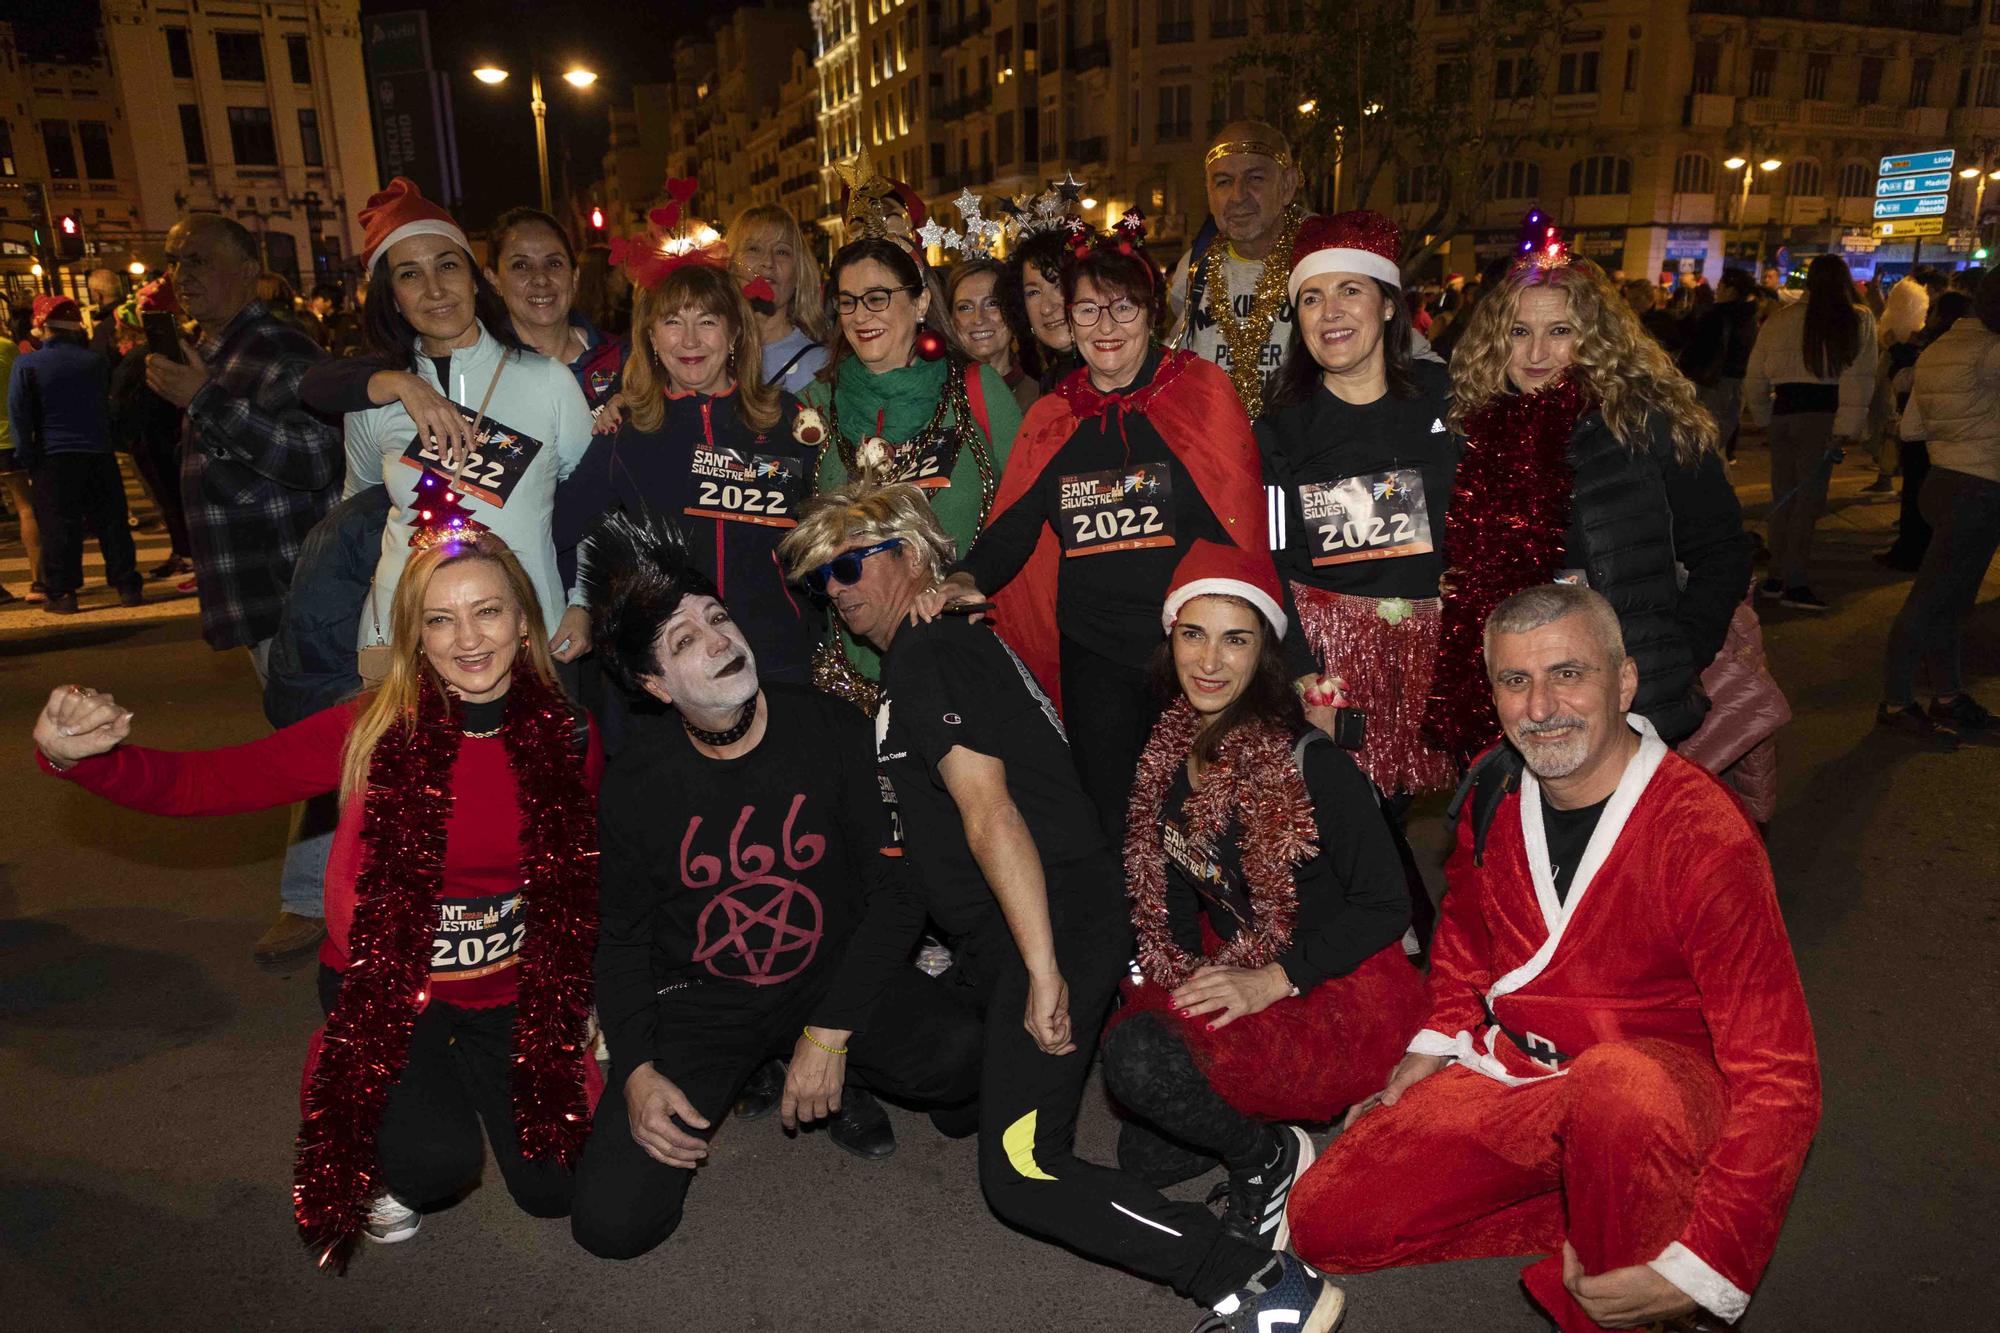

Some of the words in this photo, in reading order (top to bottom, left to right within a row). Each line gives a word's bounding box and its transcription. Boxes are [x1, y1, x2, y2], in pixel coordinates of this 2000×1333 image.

[1215, 344, 1282, 365] PEER
[693, 449, 734, 469] SANT
[699, 481, 788, 514] 2022
[1061, 479, 1100, 499] SANT
[1072, 505, 1164, 543] 2022
[1318, 512, 1416, 552] 2022
[679, 793, 827, 889] 666
